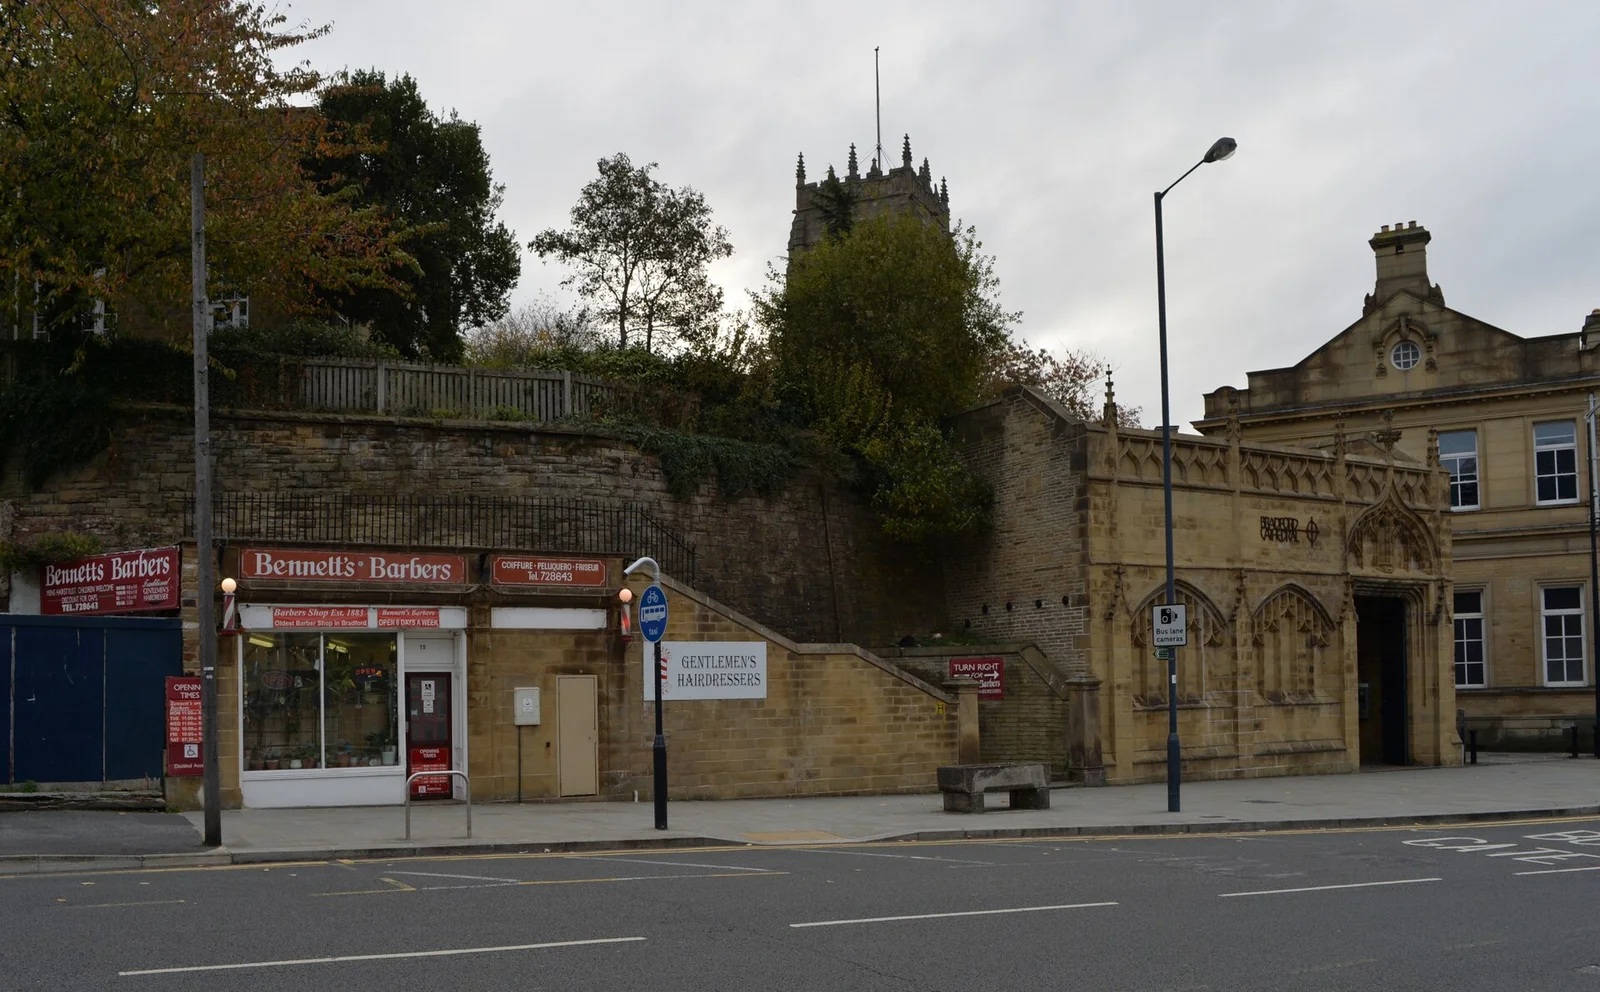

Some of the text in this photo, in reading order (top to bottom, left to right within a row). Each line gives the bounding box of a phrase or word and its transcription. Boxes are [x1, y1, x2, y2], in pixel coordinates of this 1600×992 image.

[45, 551, 170, 586] Bennetts Barbers
[254, 552, 452, 580] Bennett's Barbers
[501, 561, 599, 572] COIFFURE PELUQUERO FRISEUR
[540, 571, 573, 582] 728643
[96, 584, 114, 592] WELCOME
[308, 608, 329, 618] Shop
[347, 609, 364, 617] 1883
[317, 620, 333, 628] Shop
[648, 626, 659, 636] taxi
[1156, 635, 1184, 643] cameras
[681, 655, 757, 669] GENTLEMEN'S
[977, 663, 999, 671] RIGHT
[677, 672, 761, 687] HAIRDRESSERS
[180, 691, 200, 699] TIMES
